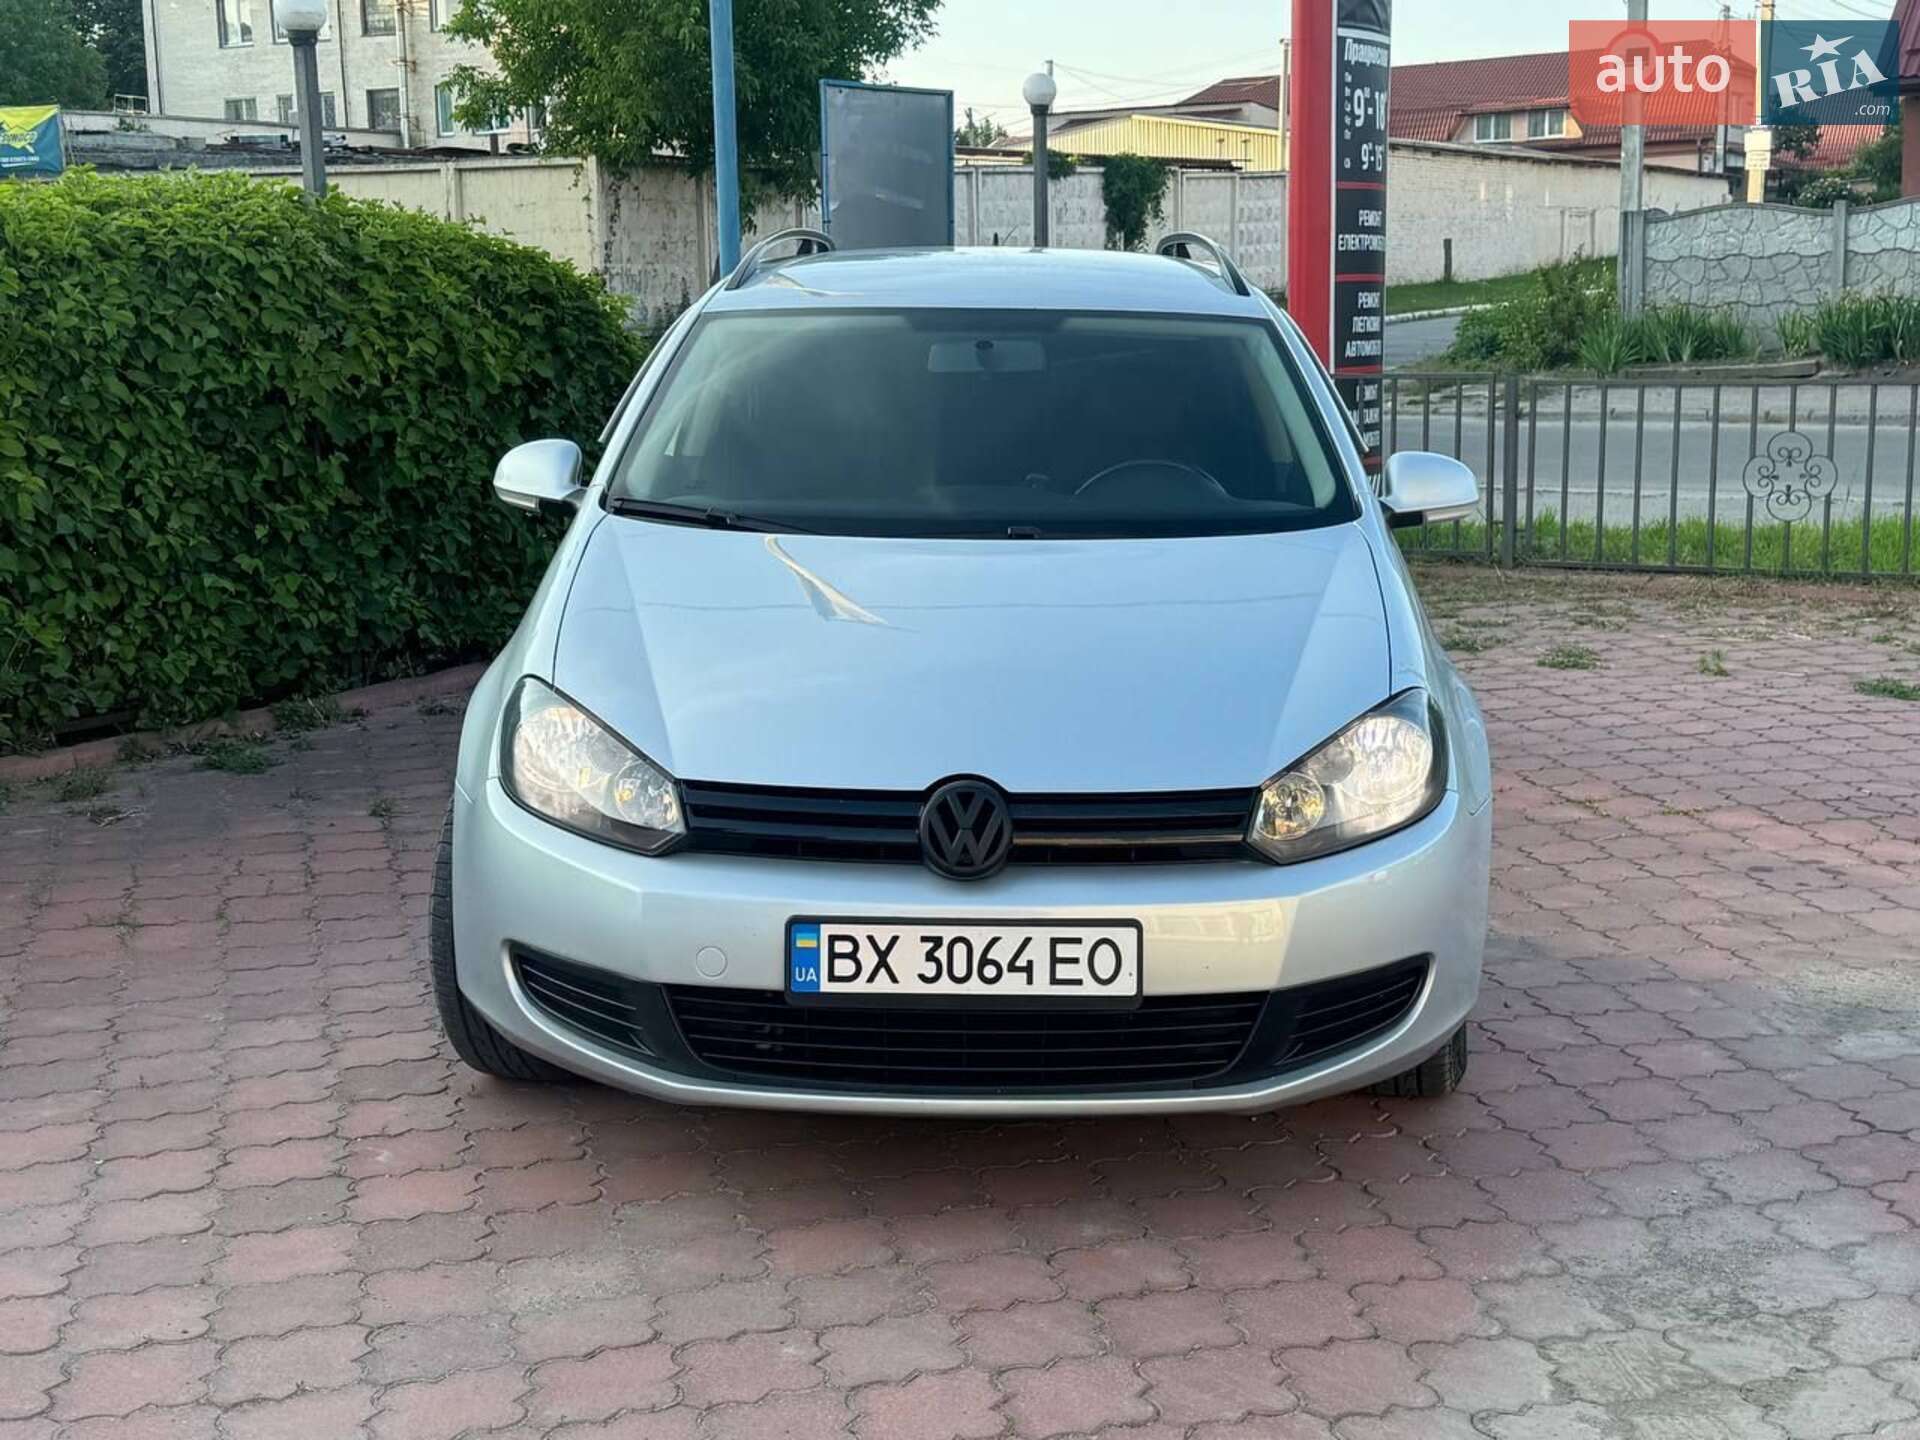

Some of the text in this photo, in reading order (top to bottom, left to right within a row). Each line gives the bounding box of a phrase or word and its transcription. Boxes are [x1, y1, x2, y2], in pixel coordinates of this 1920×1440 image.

[795, 966, 818, 982] UA
[826, 933, 1123, 986] BX 3064 EO
